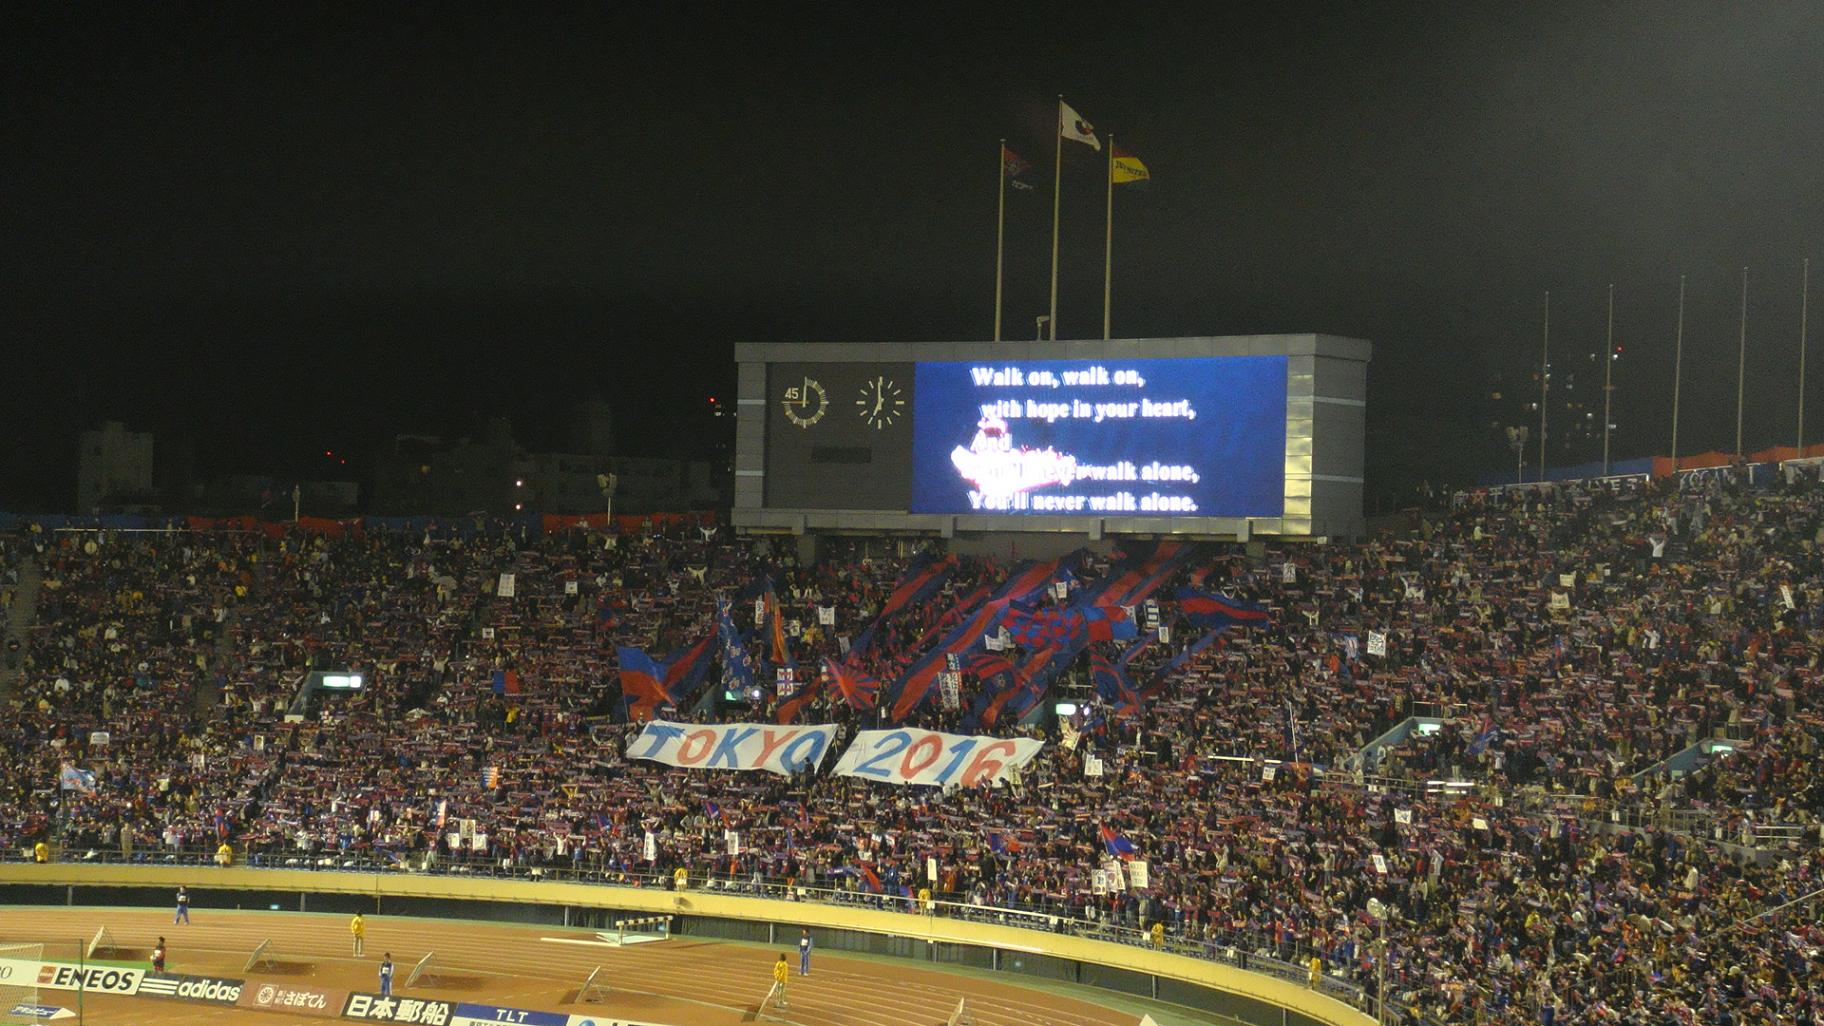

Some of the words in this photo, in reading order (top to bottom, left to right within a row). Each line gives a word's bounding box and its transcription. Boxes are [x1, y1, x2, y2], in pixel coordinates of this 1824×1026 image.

[970, 367, 1023, 386] Walk
[1027, 369, 1060, 388] on,
[1063, 366, 1109, 386] walk
[1114, 369, 1146, 388] on,
[784, 387, 799, 399] 45
[981, 400, 1023, 418] with
[1026, 399, 1069, 422] hope
[1073, 399, 1093, 417] in
[1094, 402, 1138, 422] your
[1141, 398, 1196, 420] heart,
[970, 430, 1012, 452] And
[1090, 461, 1137, 481] walk
[1141, 461, 1200, 483] alone,
[968, 491, 1030, 510] You'll
[1033, 494, 1086, 511] never
[1088, 492, 1136, 511] walk
[1141, 492, 1198, 511] alone.
[644, 726, 826, 776] TOKYO
[853, 730, 1016, 788] 2016
[54, 967, 135, 990] ENEOS
[178, 979, 240, 1001] adidas
[347, 995, 450, 1026] 日本郵船
[496, 1009, 529, 1023] TLT
